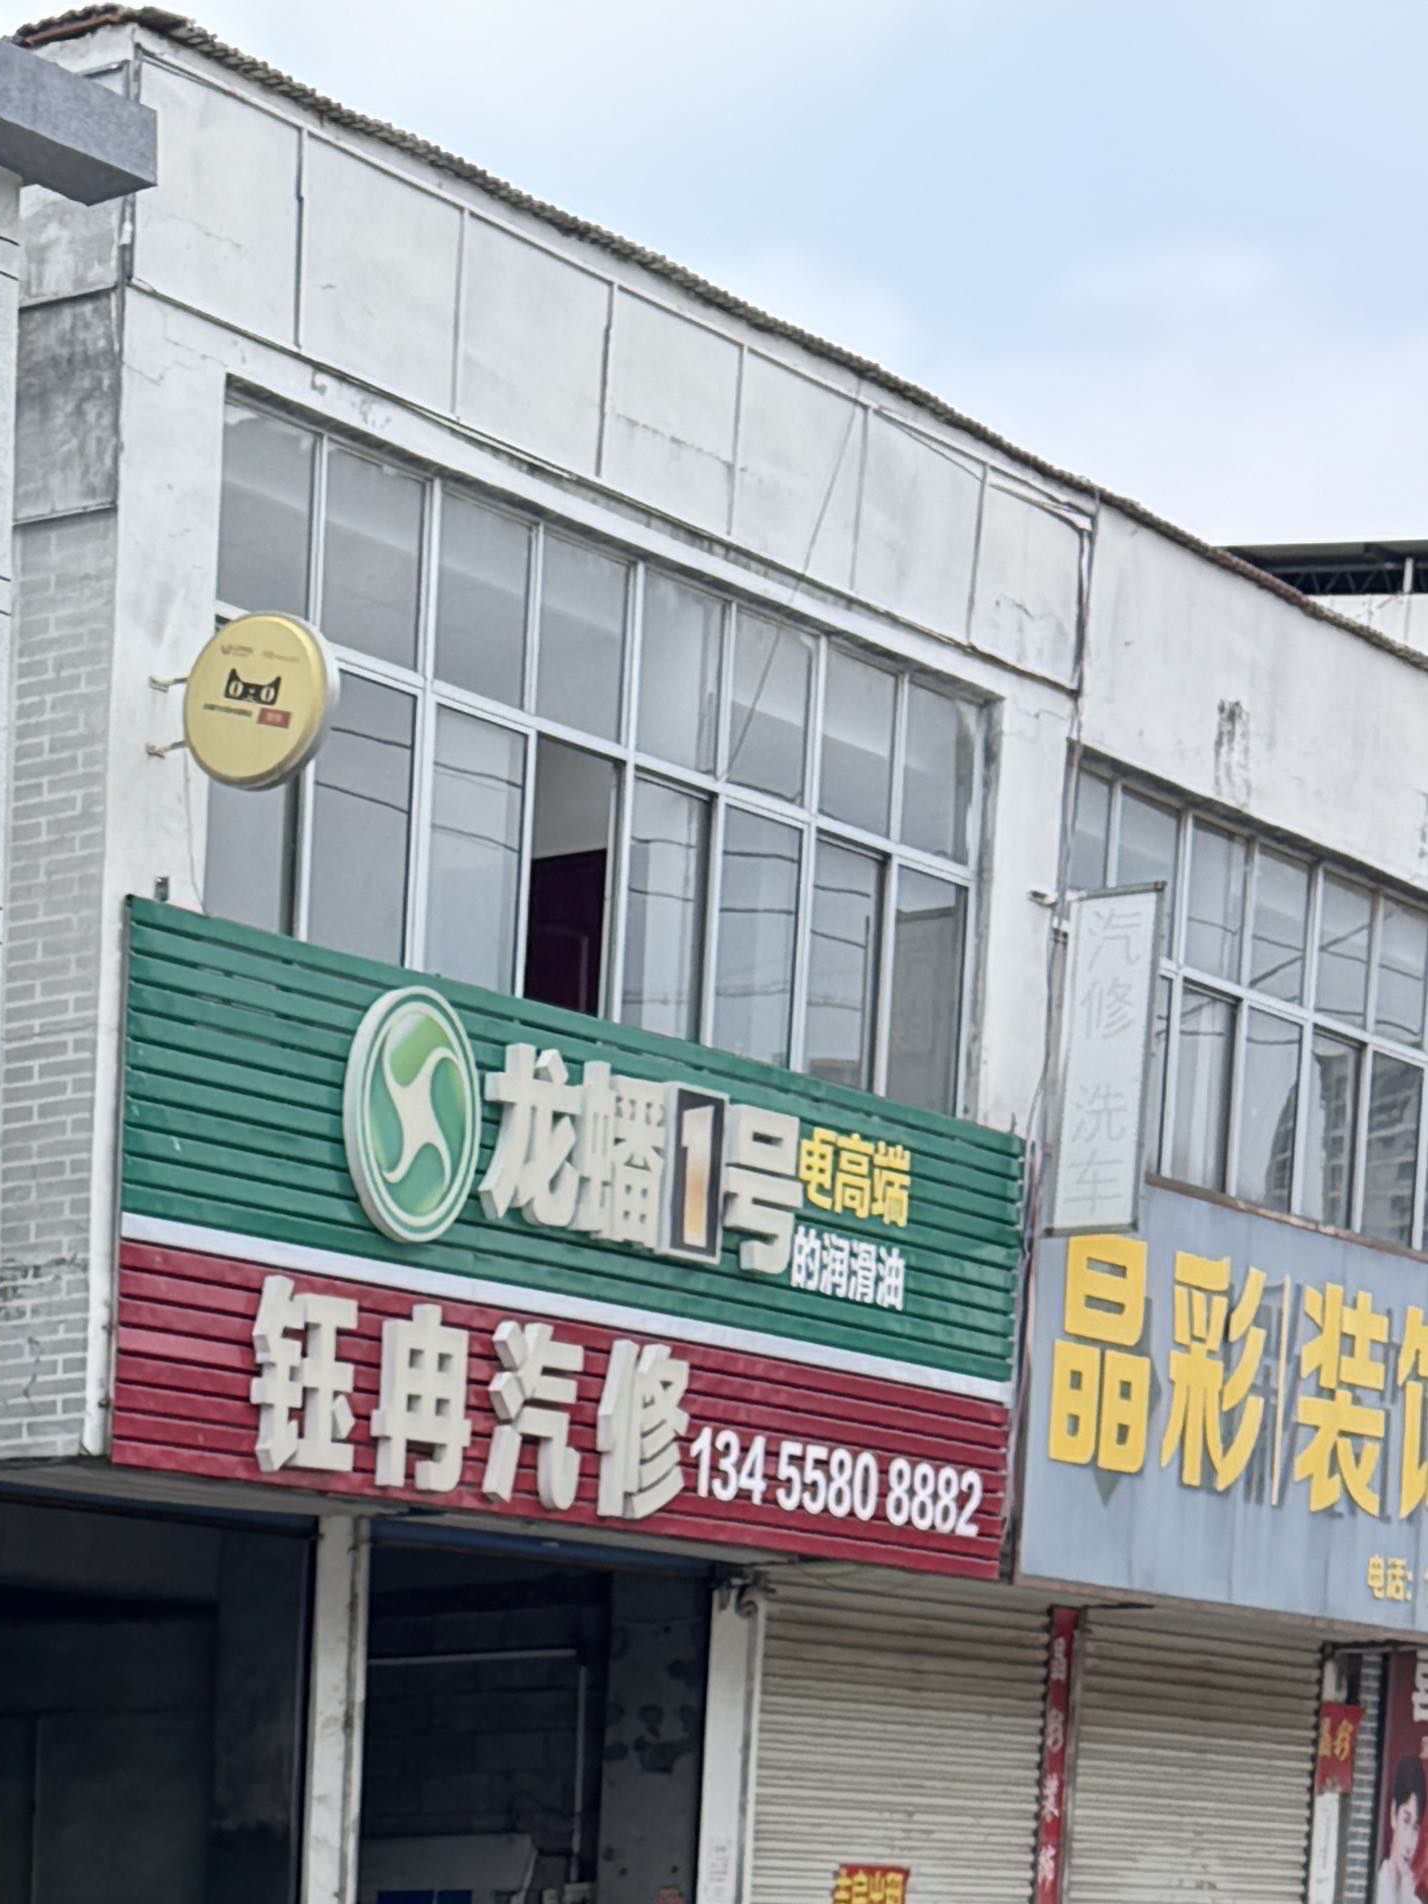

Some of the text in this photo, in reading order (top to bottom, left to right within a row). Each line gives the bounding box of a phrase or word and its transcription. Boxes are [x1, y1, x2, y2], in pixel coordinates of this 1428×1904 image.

[478, 1042, 804, 1275] 龙蟠1号
[791, 1224, 906, 1312] 的润滑油
[250, 1274, 690, 1520] 钰冉汽修
[690, 1426, 984, 1538] 134 5580 8882
